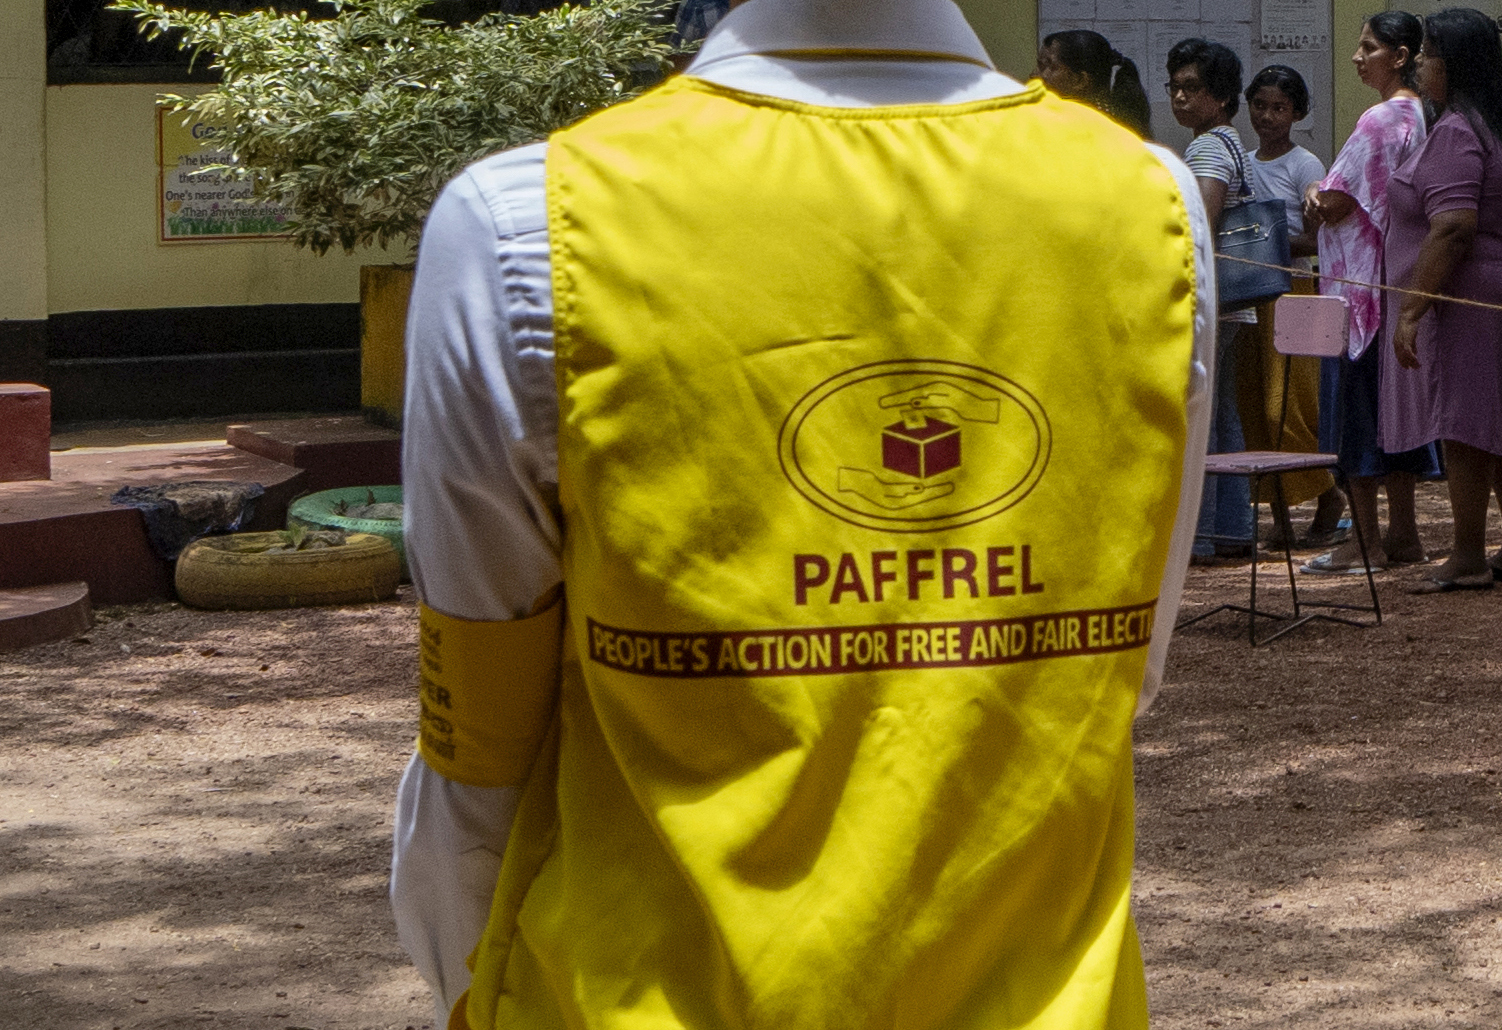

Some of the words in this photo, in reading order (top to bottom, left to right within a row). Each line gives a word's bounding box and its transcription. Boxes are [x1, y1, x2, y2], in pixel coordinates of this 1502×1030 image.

[166, 190, 193, 201] One's
[195, 190, 227, 200] nearer
[184, 207, 207, 217] Than
[793, 544, 1044, 606] PAFFREL
[592, 625, 710, 673] PEOPLE'S
[718, 634, 832, 675] ACTION
[840, 630, 889, 668] FOR
[895, 627, 962, 664] FREE
[969, 622, 1027, 661] AND
[1032, 617, 1082, 653] FAIR
